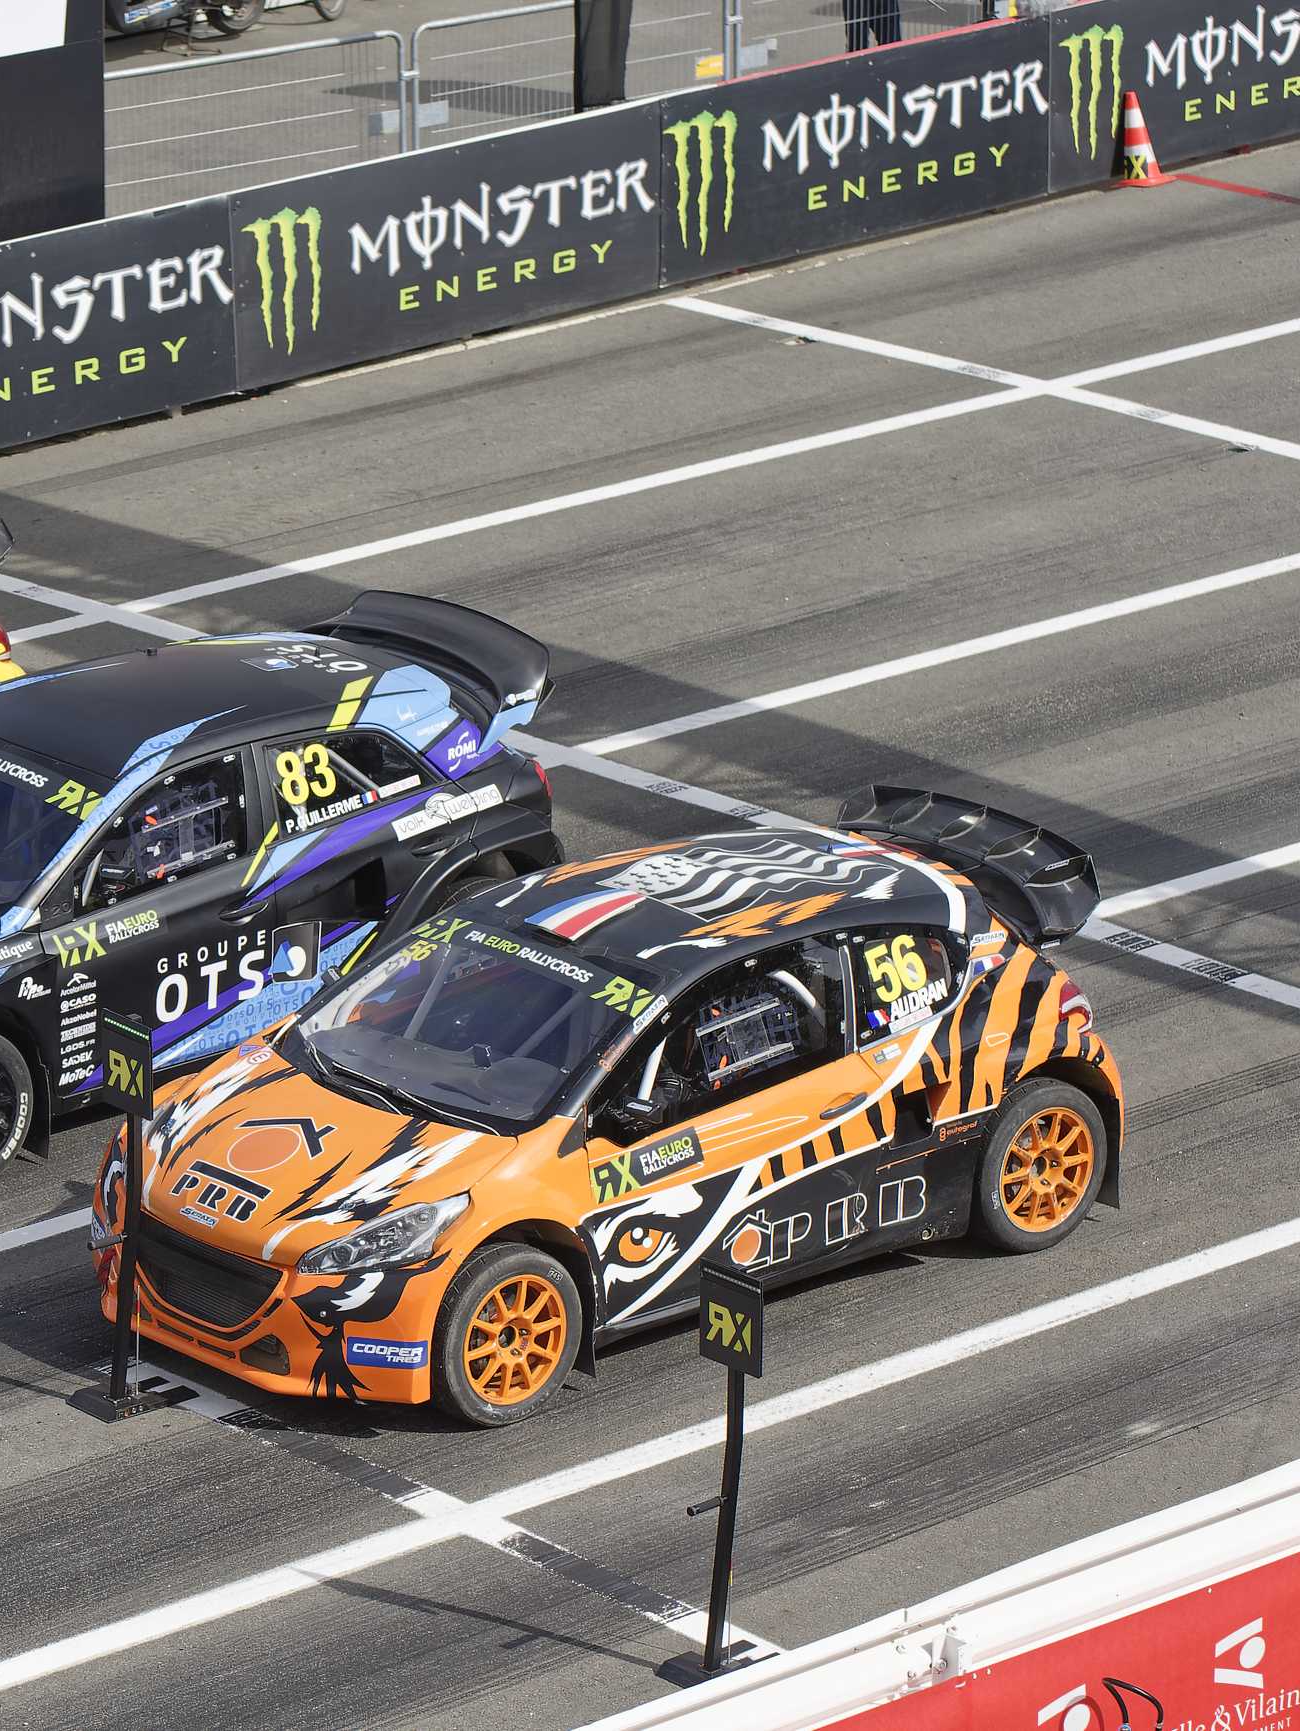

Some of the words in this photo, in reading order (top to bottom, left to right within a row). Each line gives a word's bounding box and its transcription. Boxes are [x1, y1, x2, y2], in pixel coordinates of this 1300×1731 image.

[1144, 3, 1300, 90] MONS
[762, 60, 1049, 174] MONSTER
[1184, 81, 1300, 122] ENER
[808, 144, 1010, 211] ENERGY
[1124, 153, 1148, 179] X
[348, 158, 656, 277] MONSTER
[400, 240, 613, 311] ENERGY
[448, 739, 477, 761] ROMI
[276, 743, 337, 806] 83
[108, 919, 160, 944] RALLYCROSS
[156, 929, 266, 975] GROUPE
[465, 930, 485, 944] FIA
[482, 935, 520, 954] EURO
[516, 947, 594, 985] RALLYCROSS
[864, 934, 928, 1003] 56
[155, 949, 266, 1023] OTS
[889, 977, 948, 1021] AUDRAN
[60, 1008, 97, 1027] AkzoNobel
[59, 1064, 95, 1087] MoTeC
[2, 1092, 29, 1160] COOPER
[642, 1146, 696, 1176] RALLYCROSS
[171, 1173, 258, 1223] PRB
[769, 1175, 926, 1265] PRB
[352, 1343, 423, 1357] COOPER
[385, 1354, 422, 1364] TIRES
[1233, 1688, 1300, 1726] Vilain
